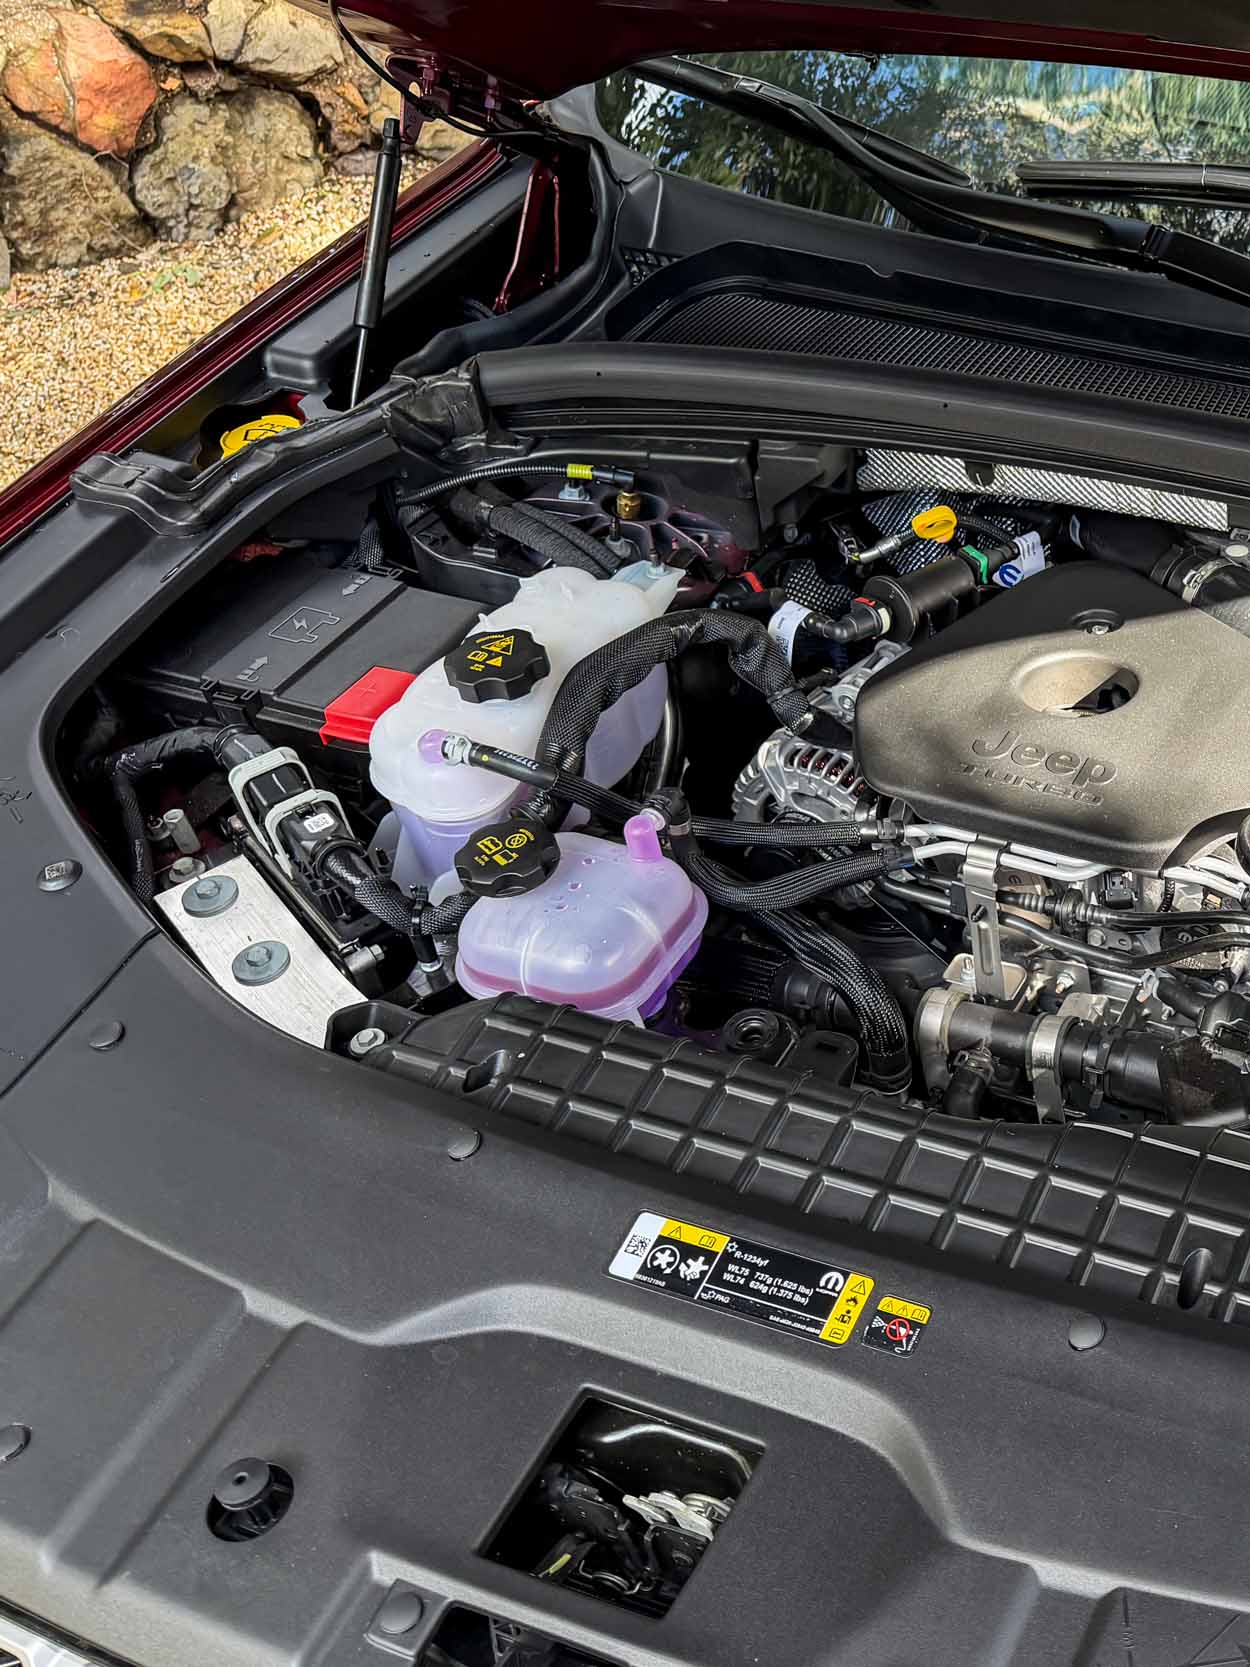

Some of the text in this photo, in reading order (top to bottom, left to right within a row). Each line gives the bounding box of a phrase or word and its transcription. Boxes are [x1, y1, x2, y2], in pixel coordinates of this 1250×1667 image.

[971, 730, 1118, 788] Jeep
[953, 761, 1104, 807] TURBO
[734, 1251, 770, 1267] R-1234yf
[723, 1272, 809, 1307] WL74 624g (1.375 lbs)
[728, 1264, 750, 1276] WL75
[754, 1271, 773, 1284] 737g
[773, 1277, 798, 1290] (1.625
[797, 1284, 814, 1297] lbs)
[714, 1293, 731, 1304] PAG
